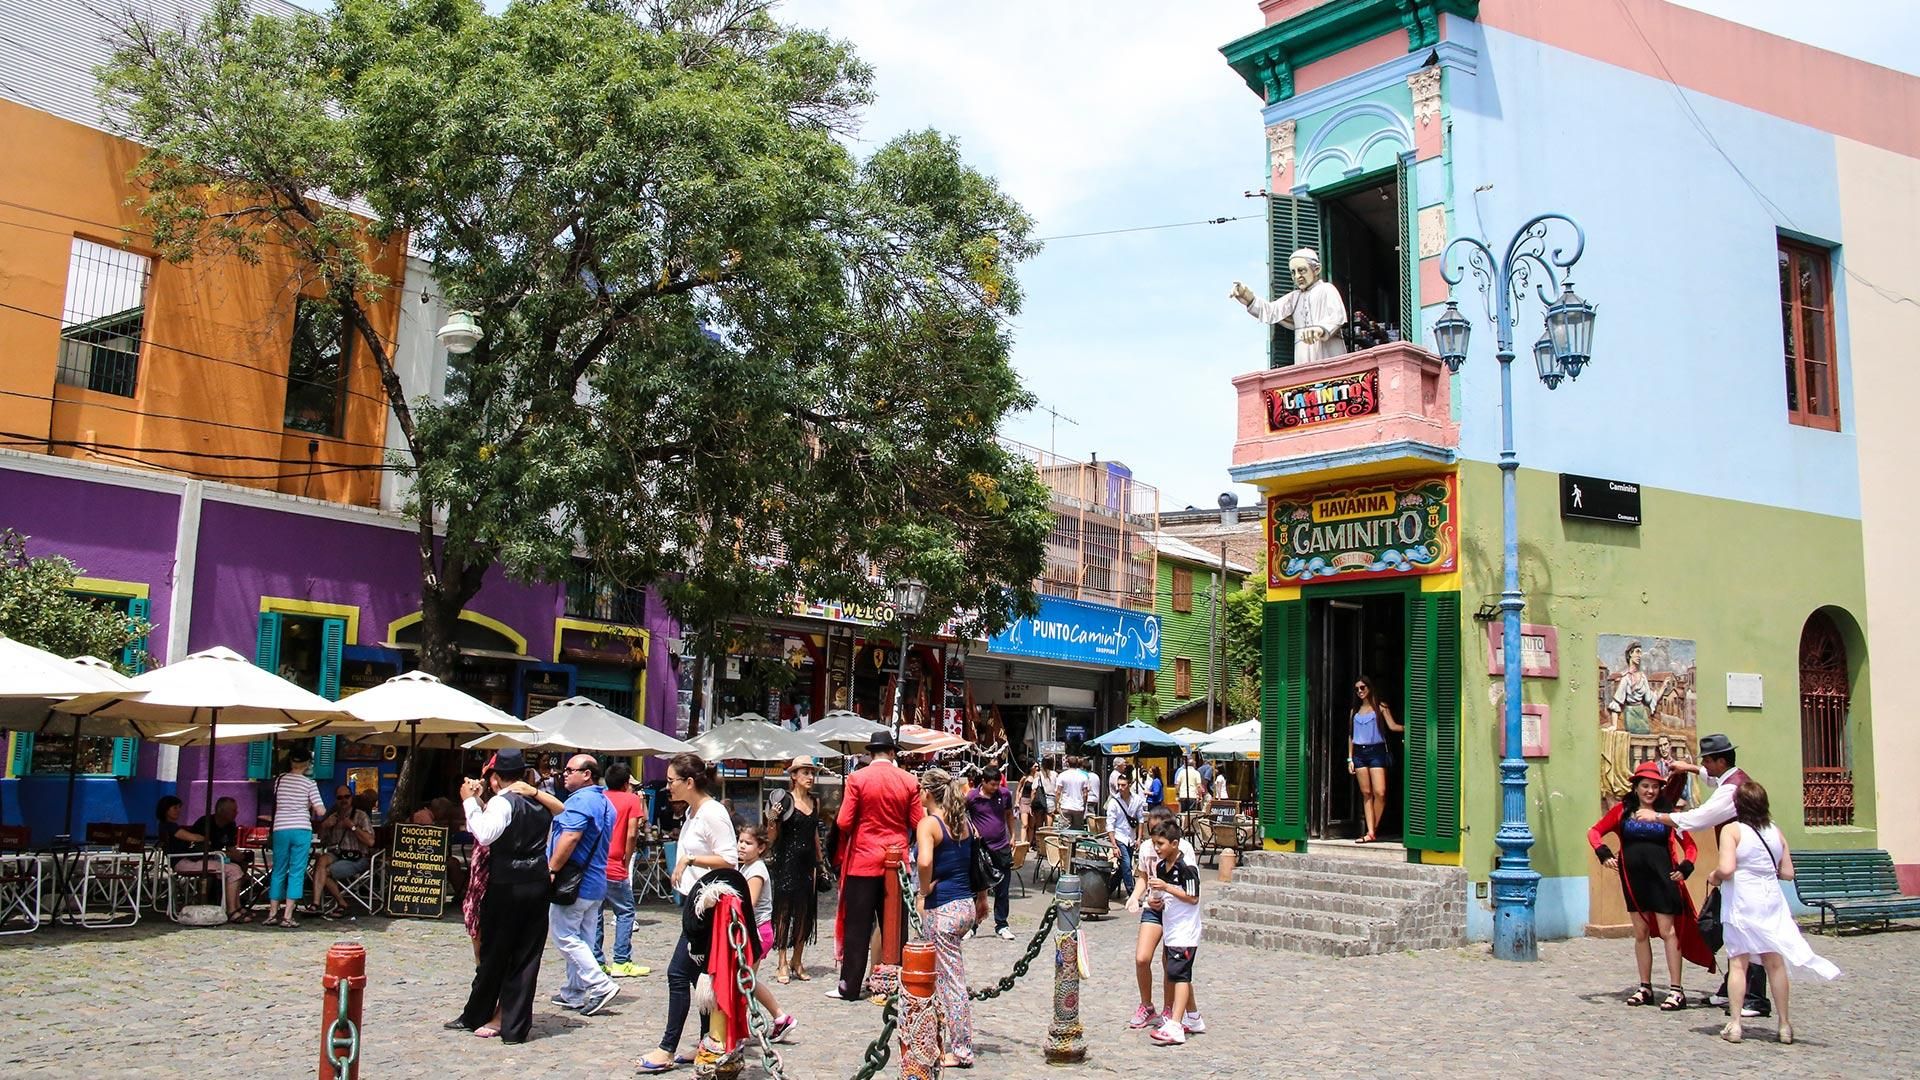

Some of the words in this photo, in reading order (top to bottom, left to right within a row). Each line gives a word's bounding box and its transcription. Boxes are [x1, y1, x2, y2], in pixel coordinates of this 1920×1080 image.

[1283, 382, 1362, 409] CAMINITO
[1299, 401, 1347, 418] AMIGO
[1609, 482, 1637, 493] Caminito
[1320, 495, 1389, 518] HAVANNA
[1617, 513, 1634, 521] Comuna
[1293, 511, 1422, 555] CAMINITO
[401, 827, 442, 837] CHOCOLATE
[395, 851, 429, 860] CHOCOLATE
[416, 863, 446, 872] CARAMELO
[398, 885, 429, 894] CROISSANT
[394, 894, 411, 902] DULCE
[420, 897, 438, 905] LECHE
